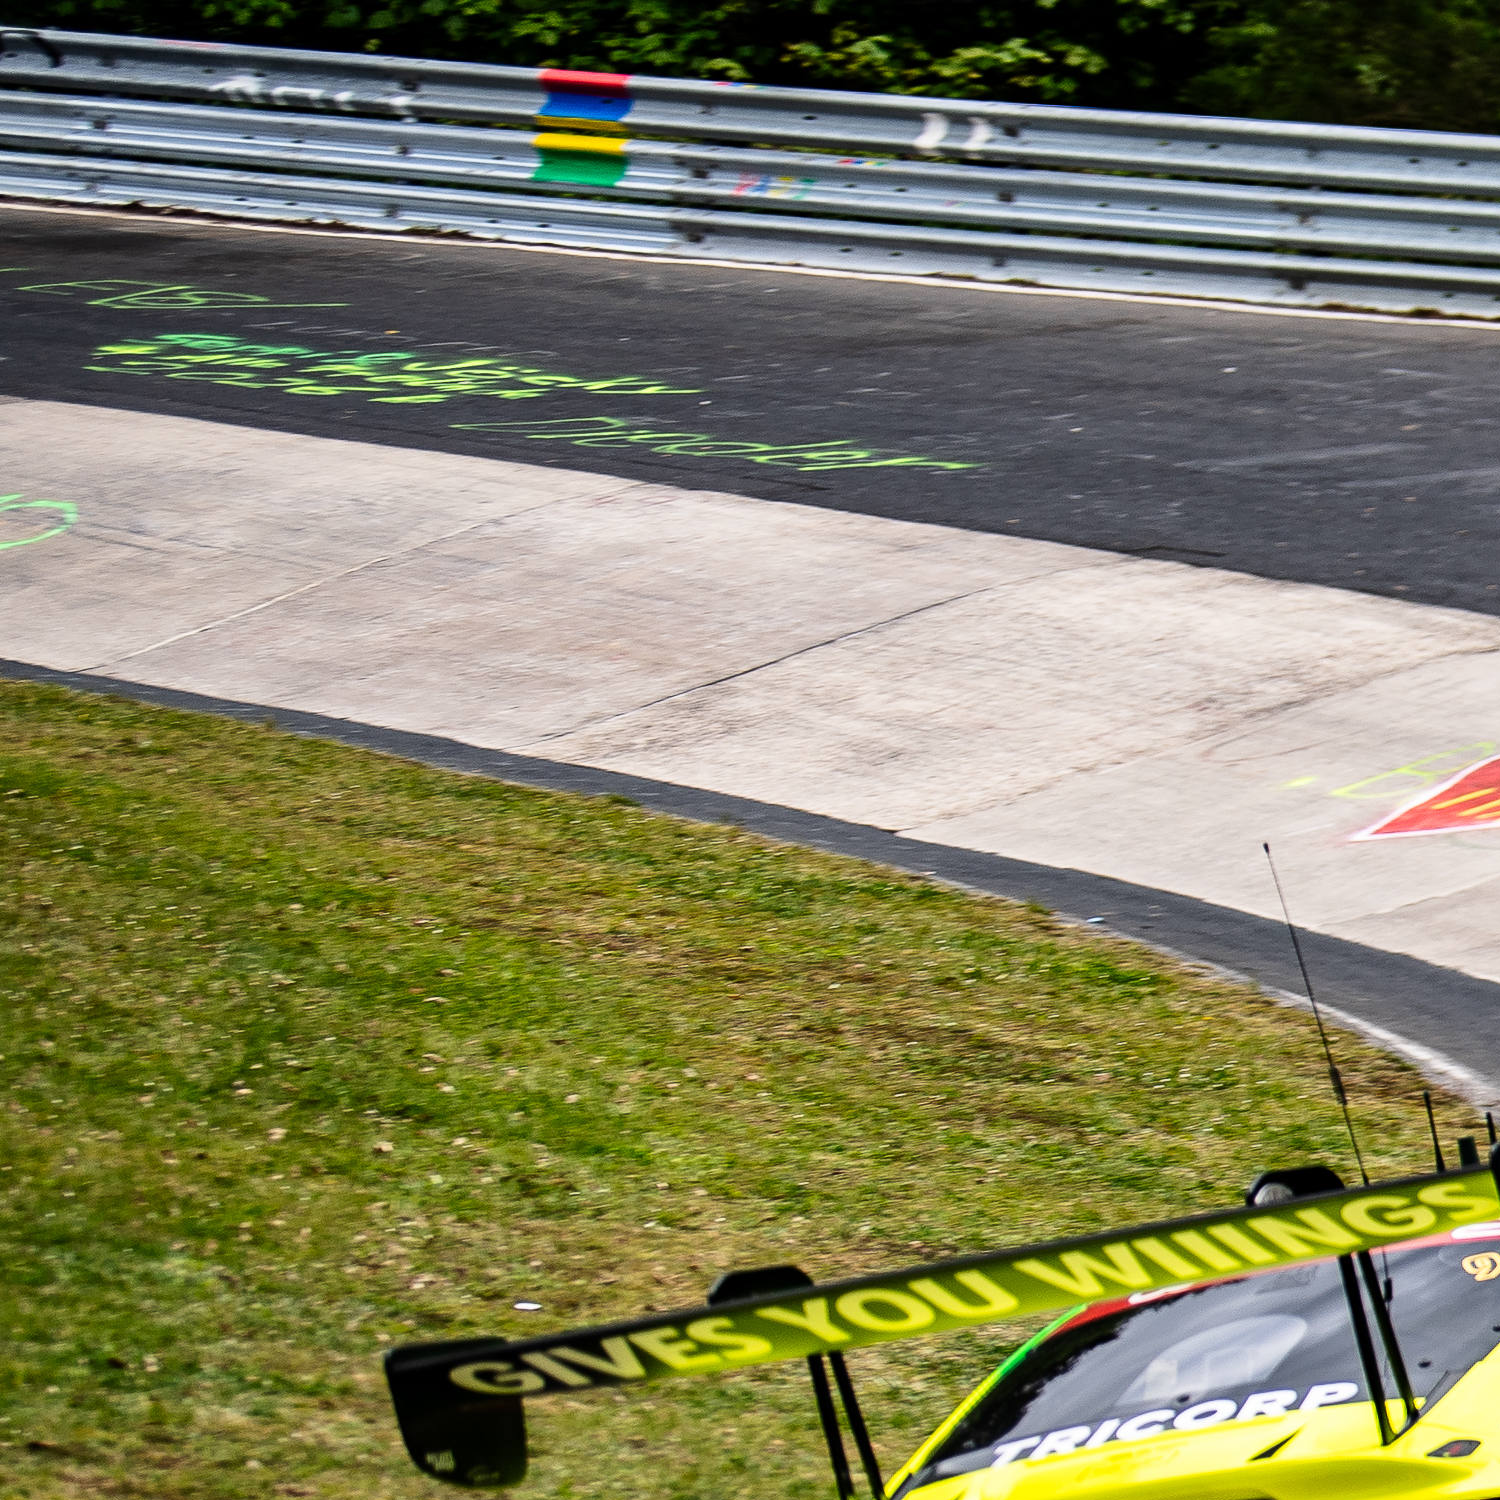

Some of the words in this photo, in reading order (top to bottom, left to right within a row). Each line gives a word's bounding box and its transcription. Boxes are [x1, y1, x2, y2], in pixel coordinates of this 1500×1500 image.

[449, 1315, 773, 1397] GIVES
[756, 1269, 1020, 1345] YOU
[990, 1380, 1360, 1468] TRICORP
